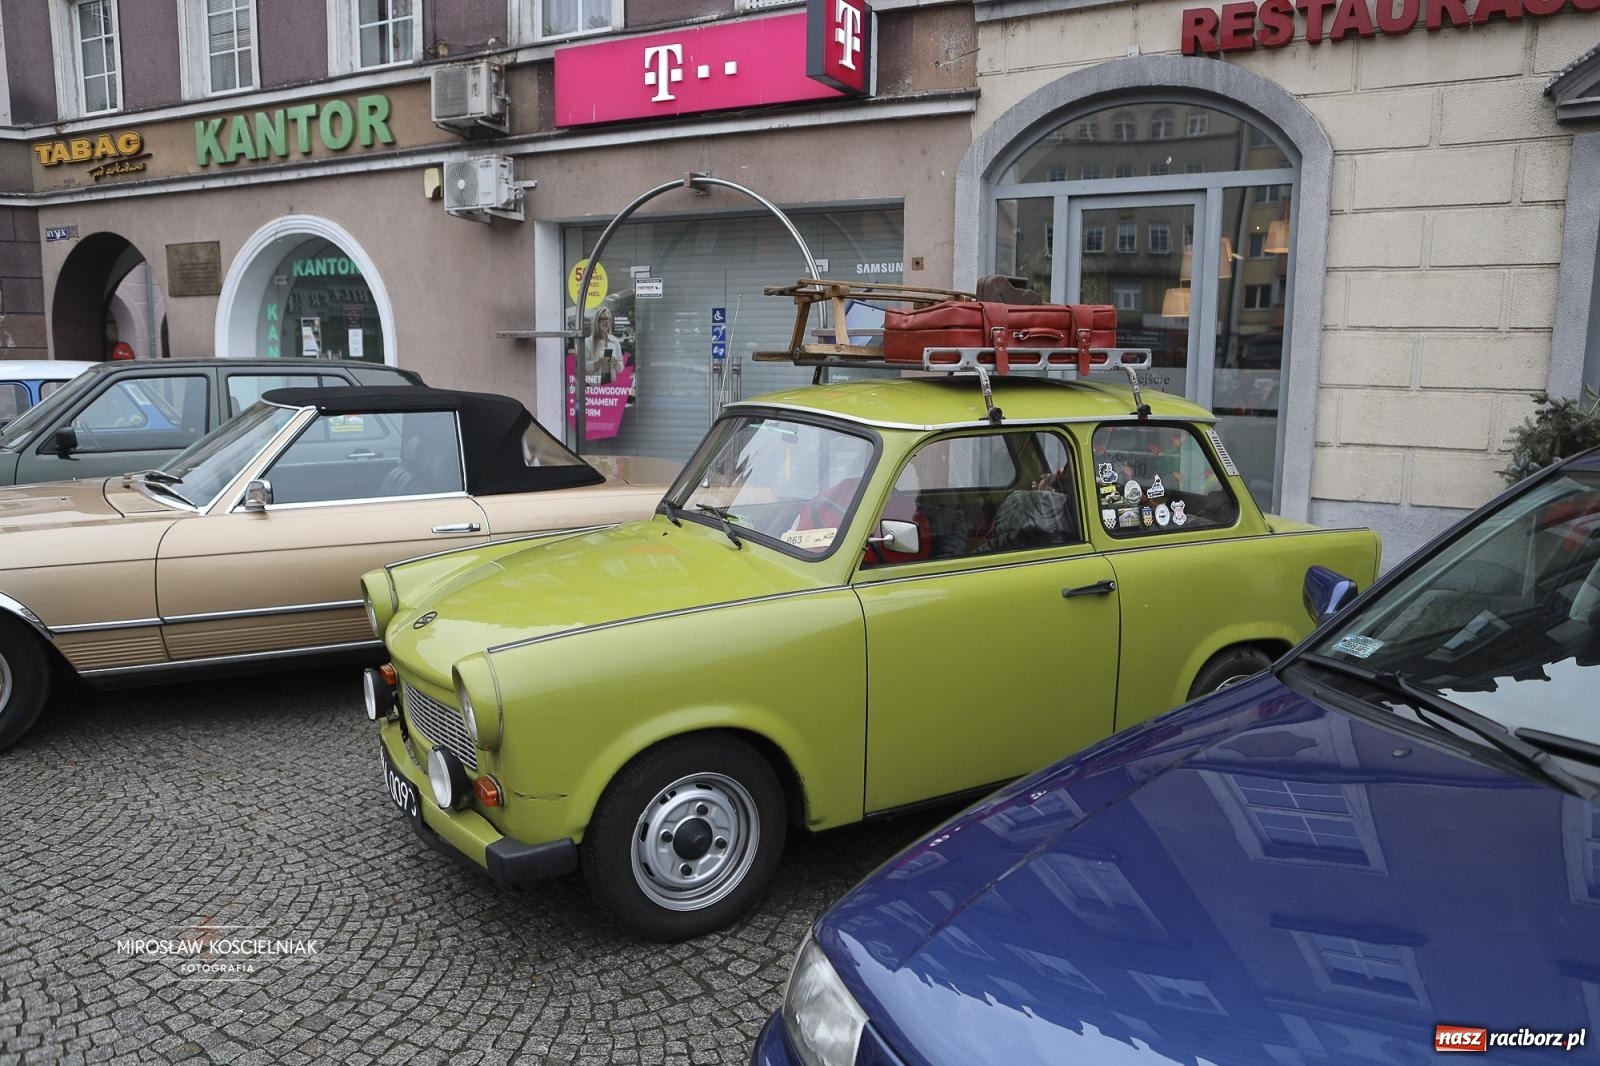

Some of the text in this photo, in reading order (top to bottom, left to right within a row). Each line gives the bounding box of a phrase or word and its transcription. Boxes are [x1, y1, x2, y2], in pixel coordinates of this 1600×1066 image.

[1181, 0, 1600, 55] RESTAURA
[195, 94, 394, 167] KANTOR
[33, 131, 143, 167] TABAC
[569, 385, 633, 395] ŚTŁOWODOWY
[1136, 373, 1170, 386] ejście
